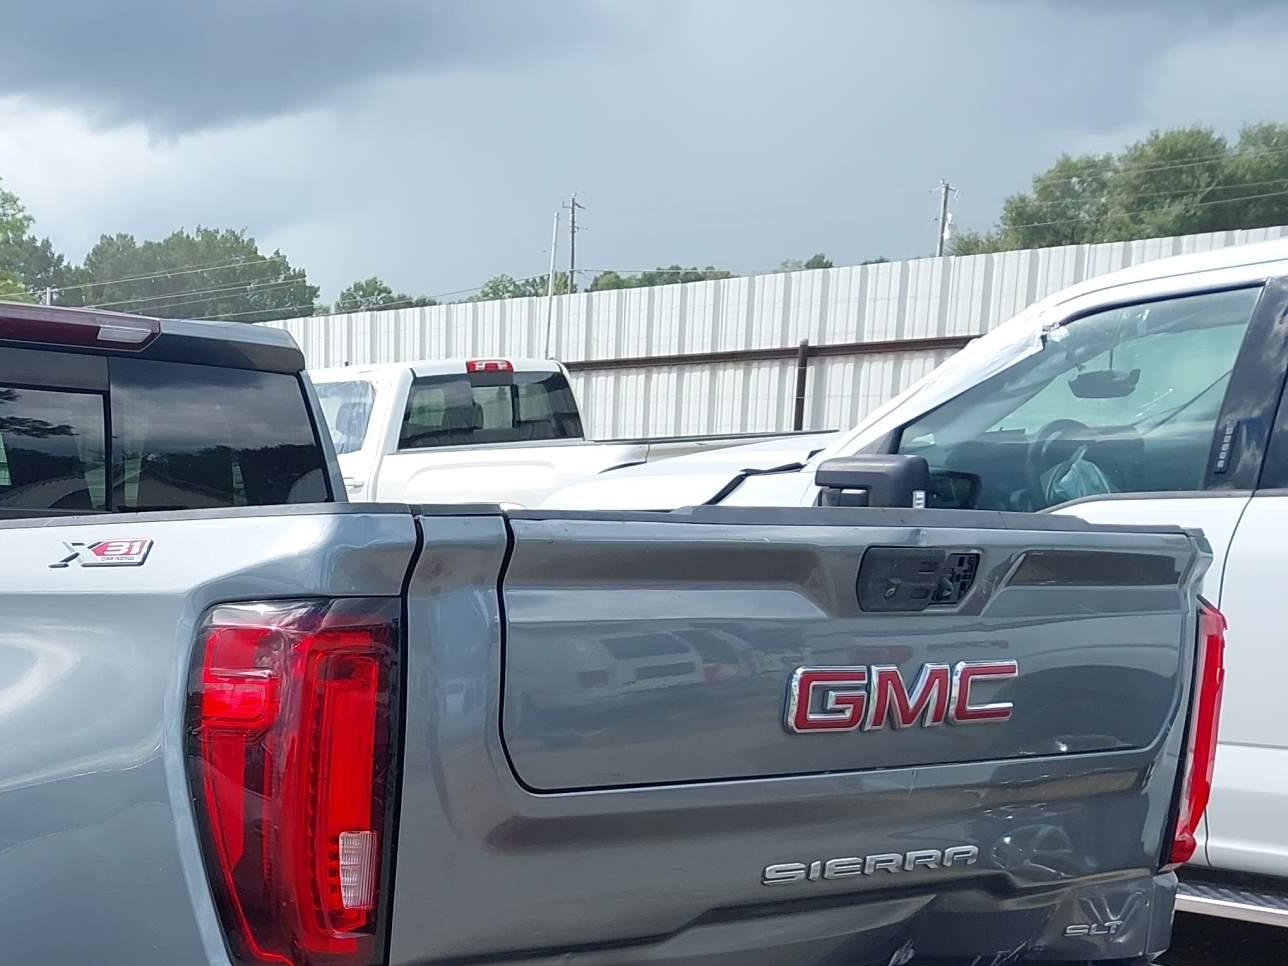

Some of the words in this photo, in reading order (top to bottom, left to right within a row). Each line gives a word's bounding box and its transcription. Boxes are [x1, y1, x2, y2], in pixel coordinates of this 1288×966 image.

[785, 660, 1018, 733] GMC
[762, 844, 979, 885] SIERRA
[1063, 920, 1123, 937] SLT
